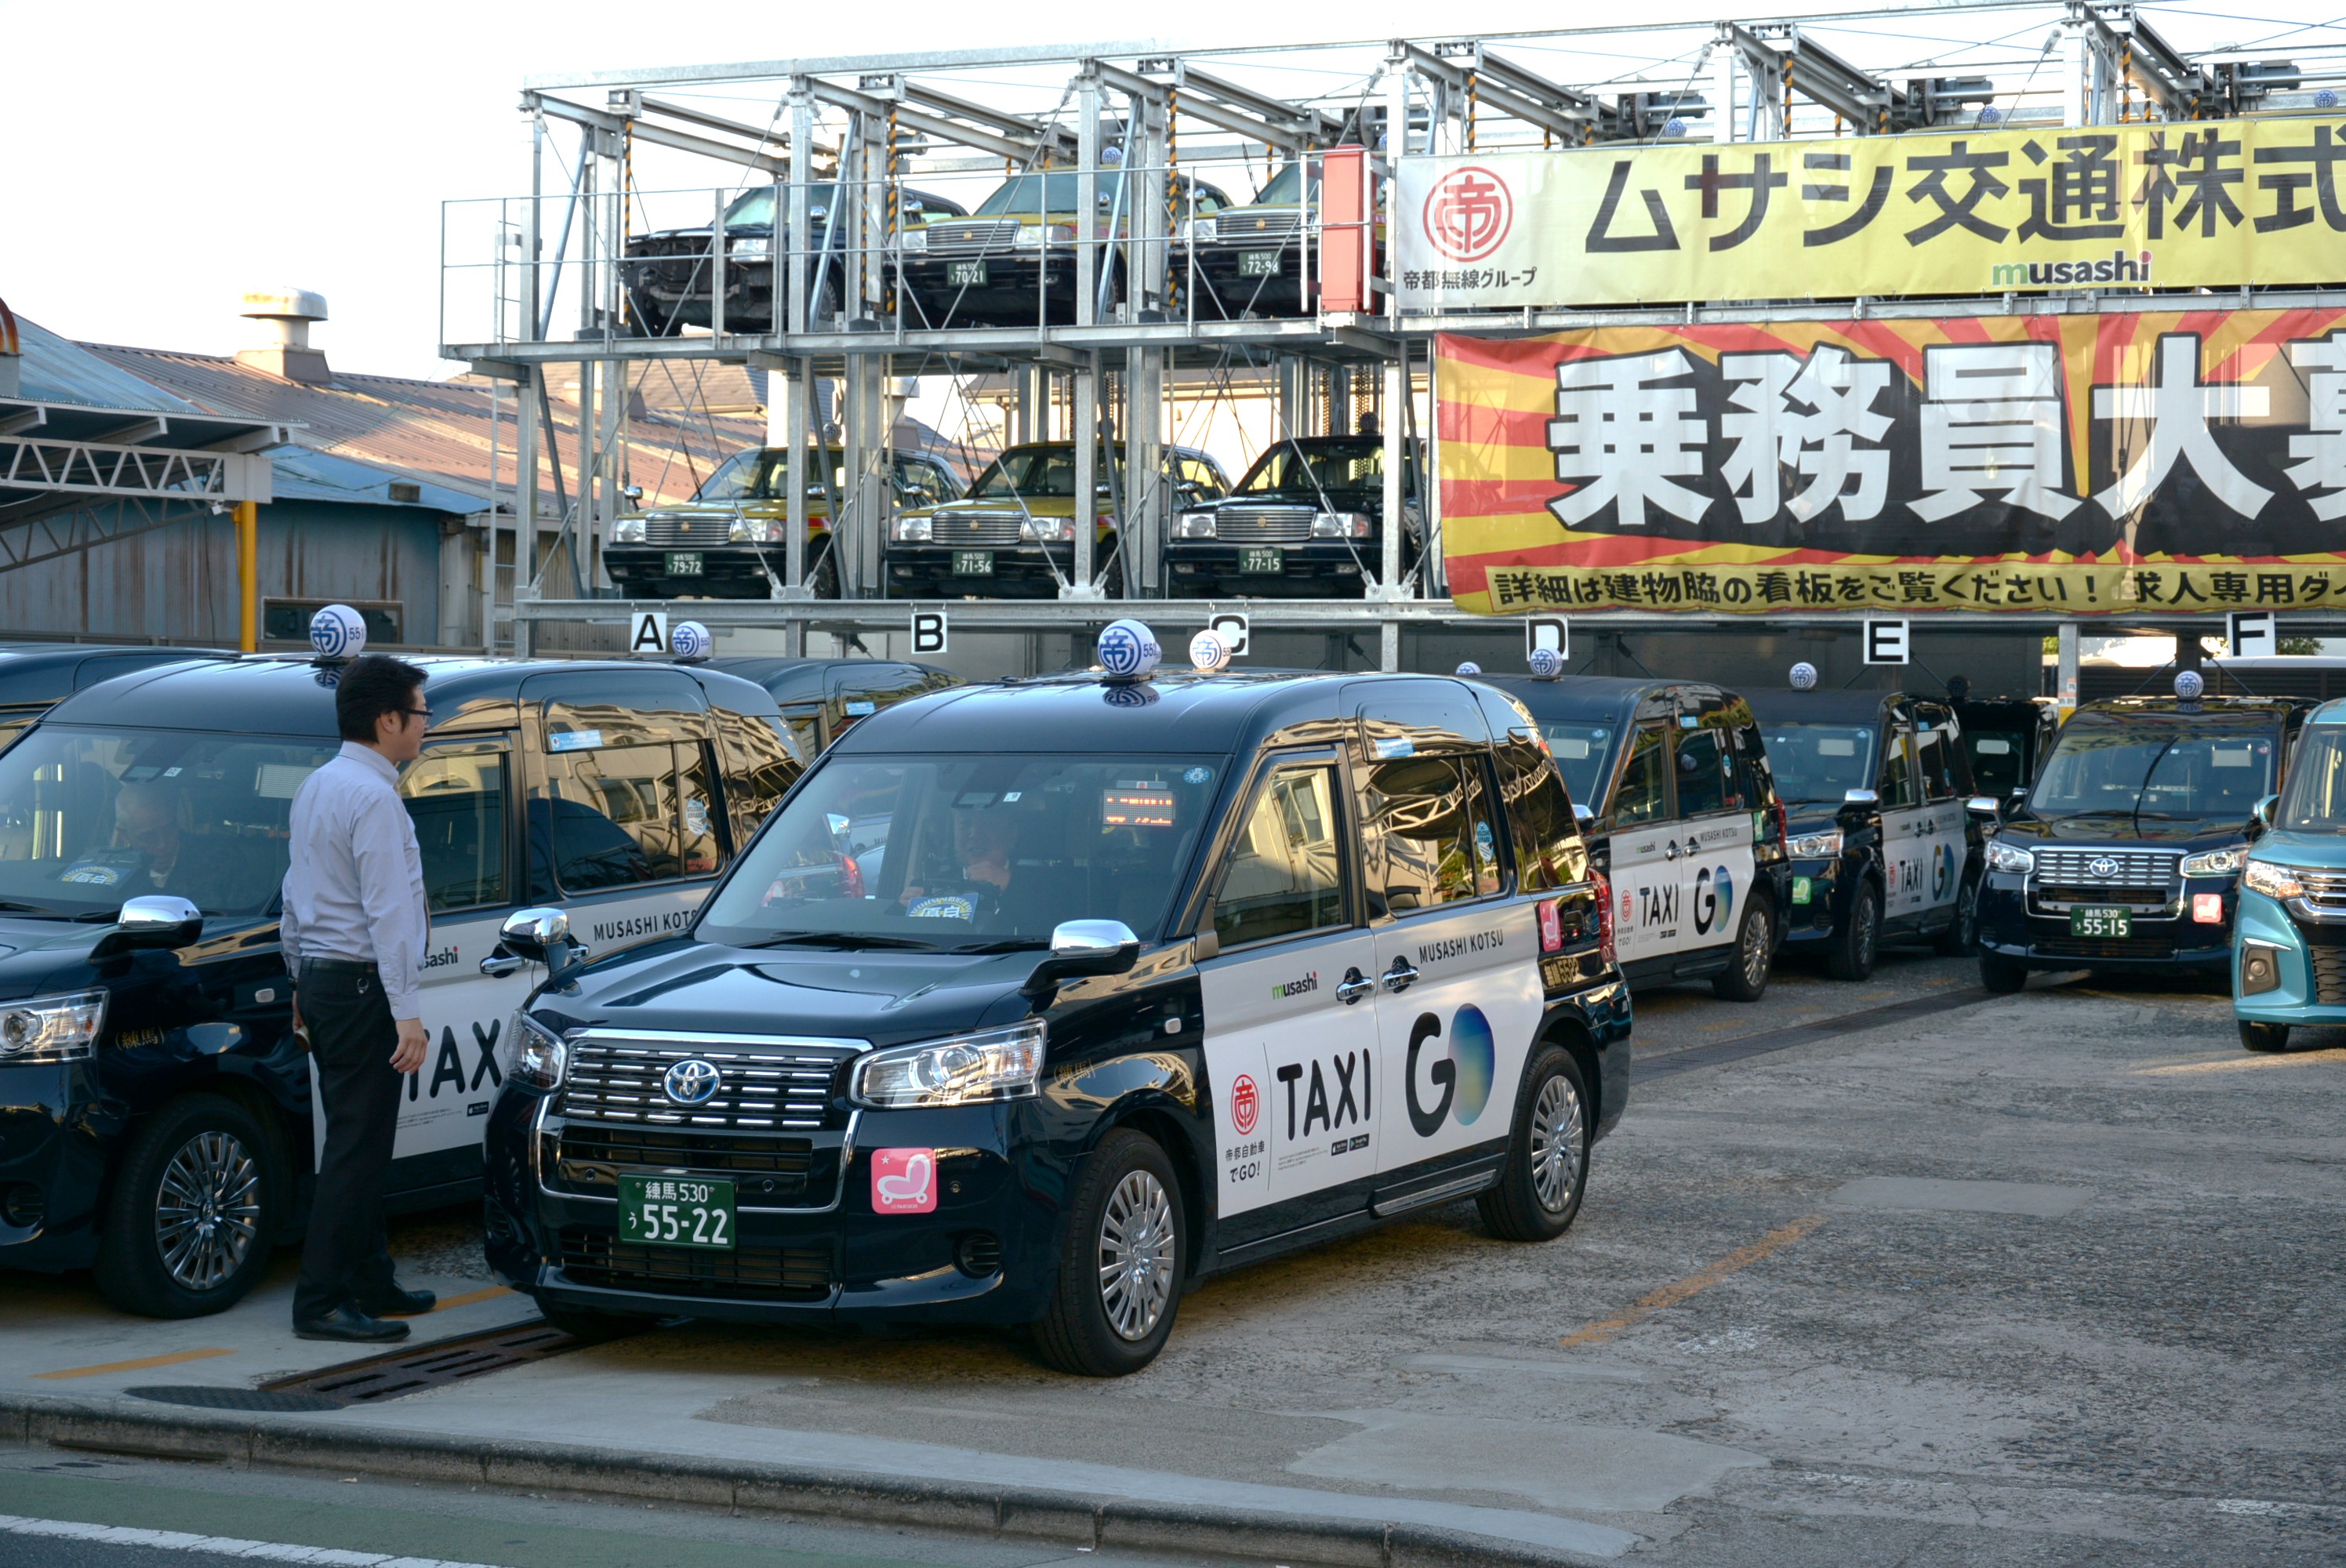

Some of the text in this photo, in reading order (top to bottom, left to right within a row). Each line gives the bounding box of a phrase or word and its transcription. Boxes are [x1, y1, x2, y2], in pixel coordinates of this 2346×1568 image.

[1404, 266, 1537, 291] 帝都無線グループ
[1992, 250, 2152, 285] musashi
[673, 561, 701, 573] 79-72
[961, 561, 991, 573] 71-56
[1248, 558, 1280, 571] 77-15
[634, 614, 663, 652] A
[914, 615, 942, 652] B
[1211, 615, 1246, 653] C
[1529, 619, 1566, 655] D
[1869, 621, 1903, 661] E
[2232, 613, 2268, 655] F
[1899, 858, 1923, 893] TAXI
[1639, 883, 1679, 927] TAXI
[594, 916, 658, 942] MUSASHI
[2083, 918, 2127, 935] 55-15
[1419, 928, 1504, 964] MUSASHI KOTSU
[1271, 971, 1318, 1000] musashi
[1405, 1003, 1495, 1138] GO
[1276, 1048, 1371, 1141] TAXI
[1229, 1161, 1260, 1183] でGO!
[628, 1204, 728, 1245] う 55-22
